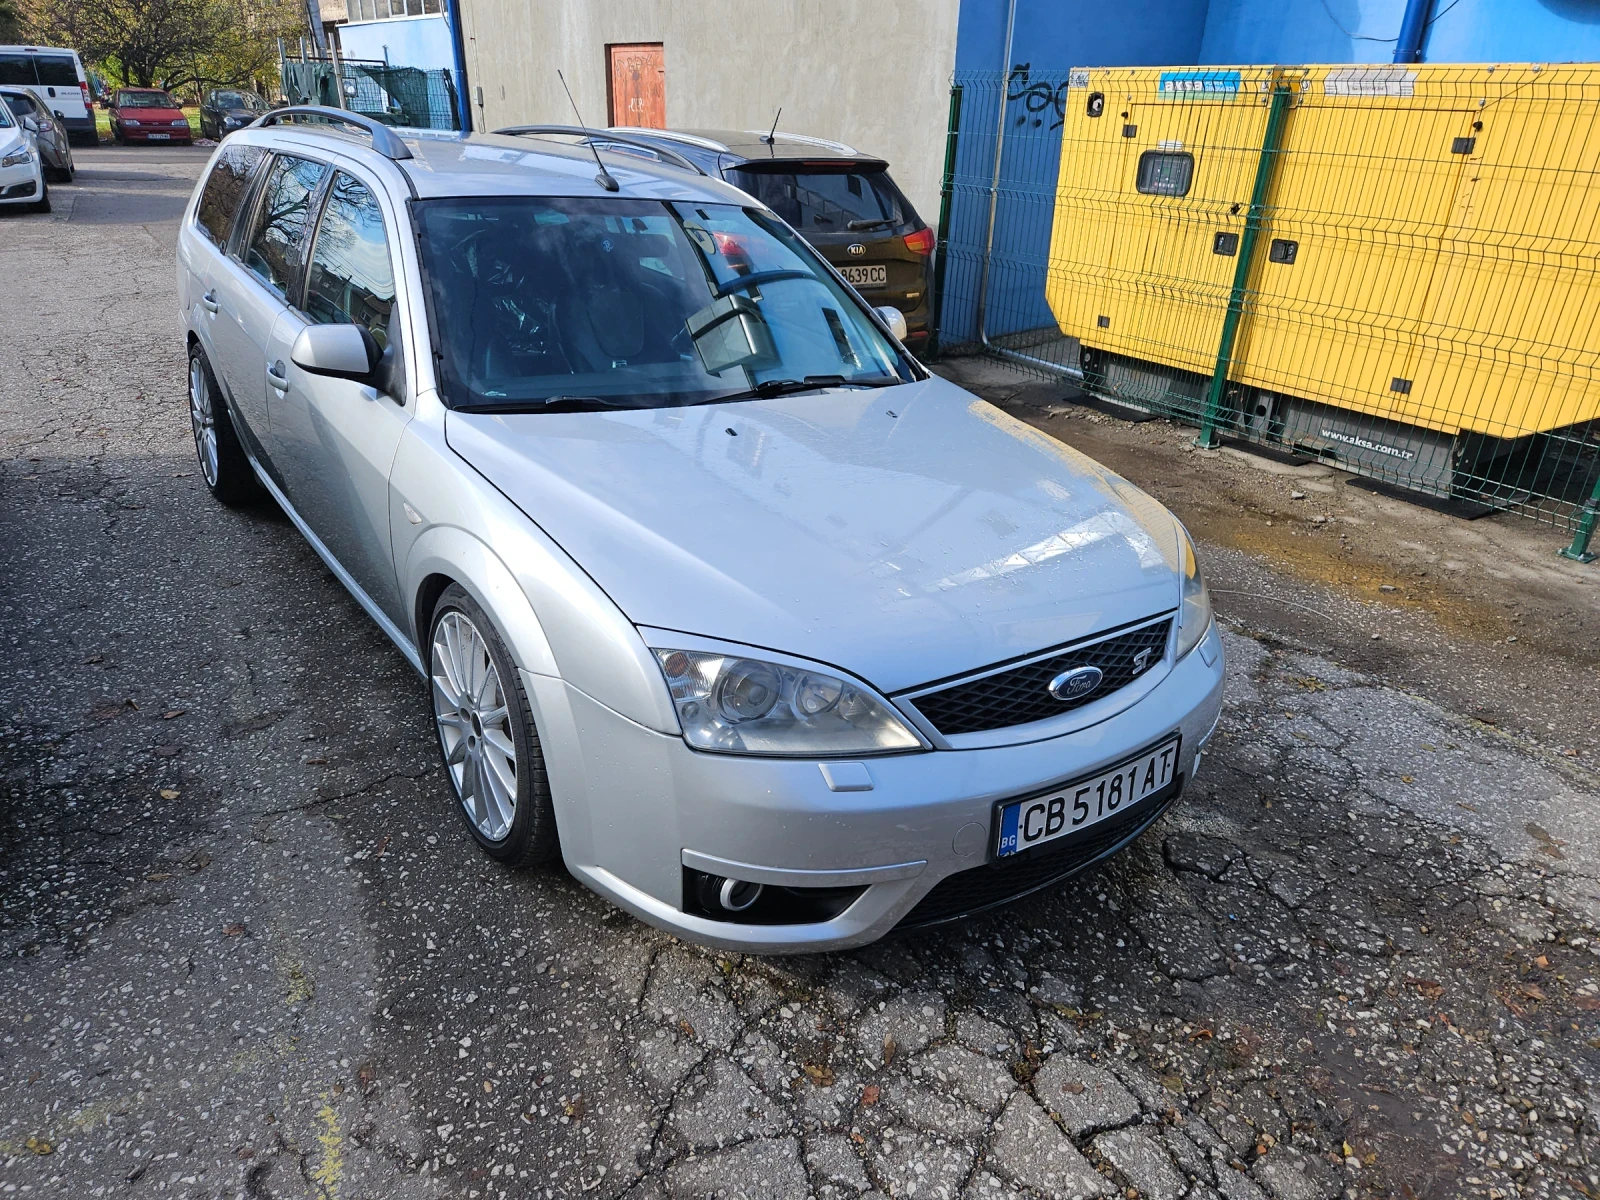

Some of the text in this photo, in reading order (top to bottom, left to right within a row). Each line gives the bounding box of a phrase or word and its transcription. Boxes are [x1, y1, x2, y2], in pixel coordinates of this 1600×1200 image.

[870, 267, 885, 282] CC
[1321, 429, 1413, 459] www.aksa.com.tr
[1132, 647, 1151, 675] ST
[1066, 675, 1091, 695] Ford
[1001, 747, 1173, 848] BG CB 5181 AT
